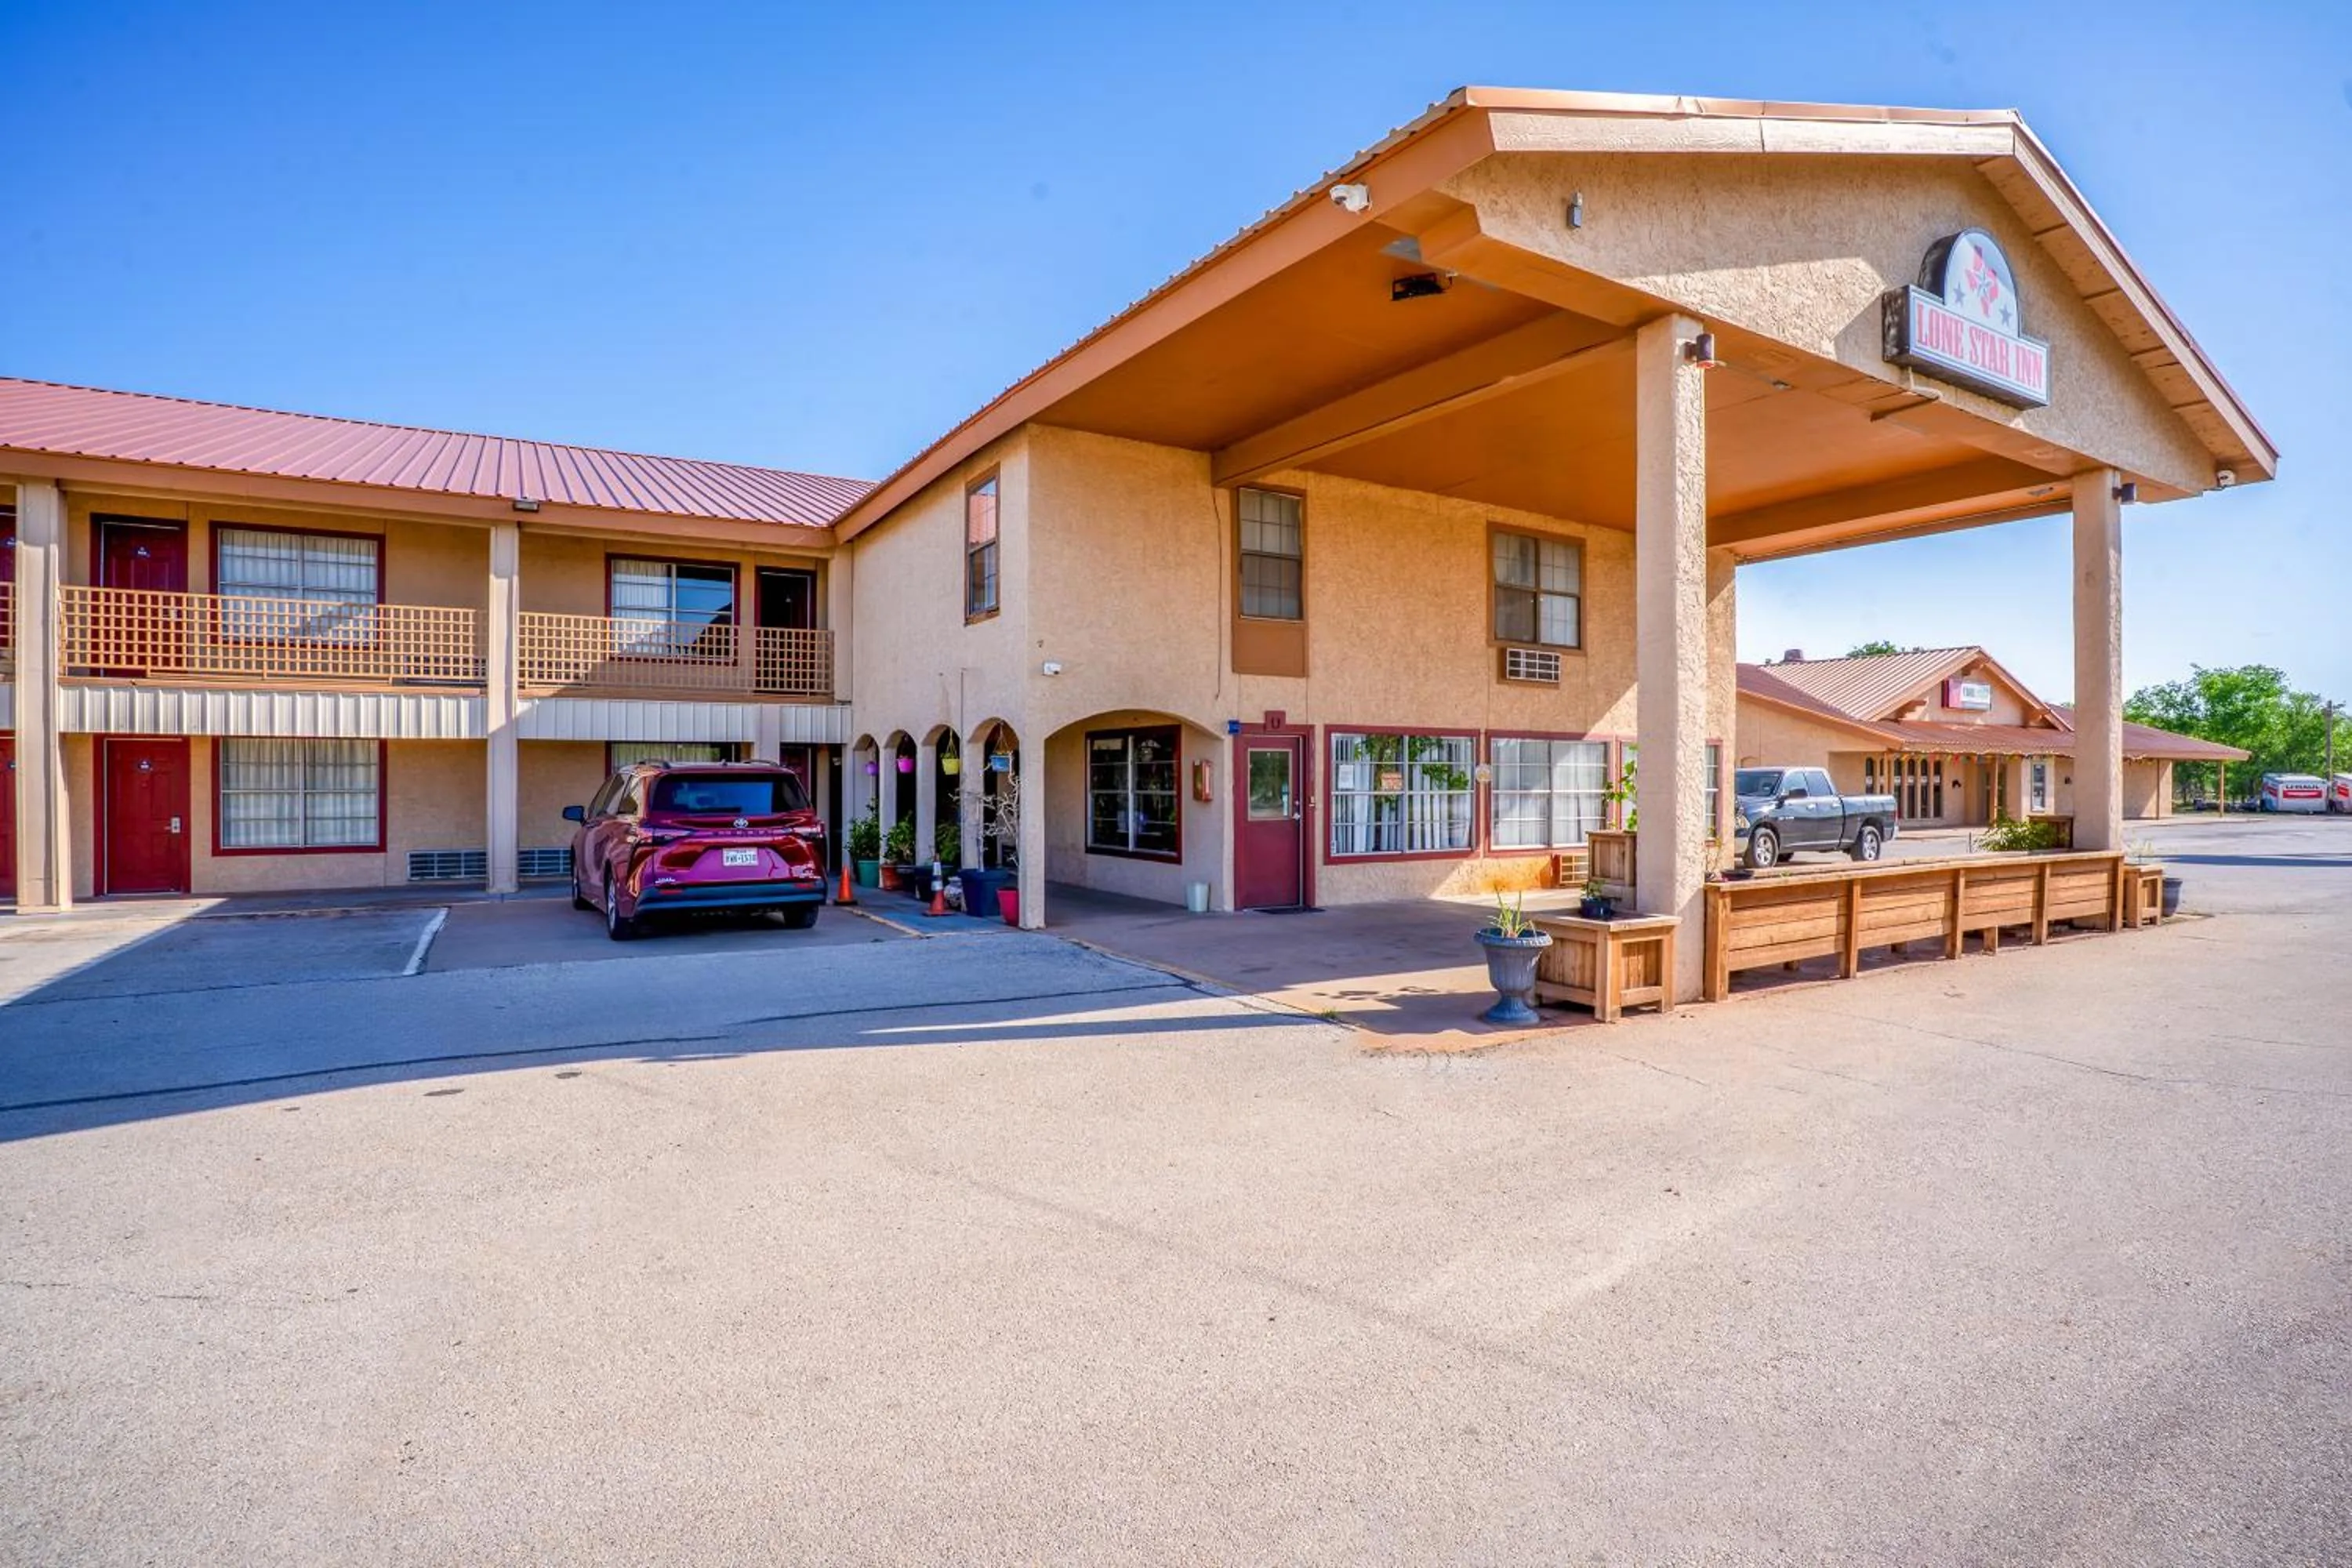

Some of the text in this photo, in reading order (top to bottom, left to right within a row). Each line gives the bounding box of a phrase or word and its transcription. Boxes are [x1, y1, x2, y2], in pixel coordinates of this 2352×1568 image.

[1917, 303, 2042, 388] LONE STAR INN
